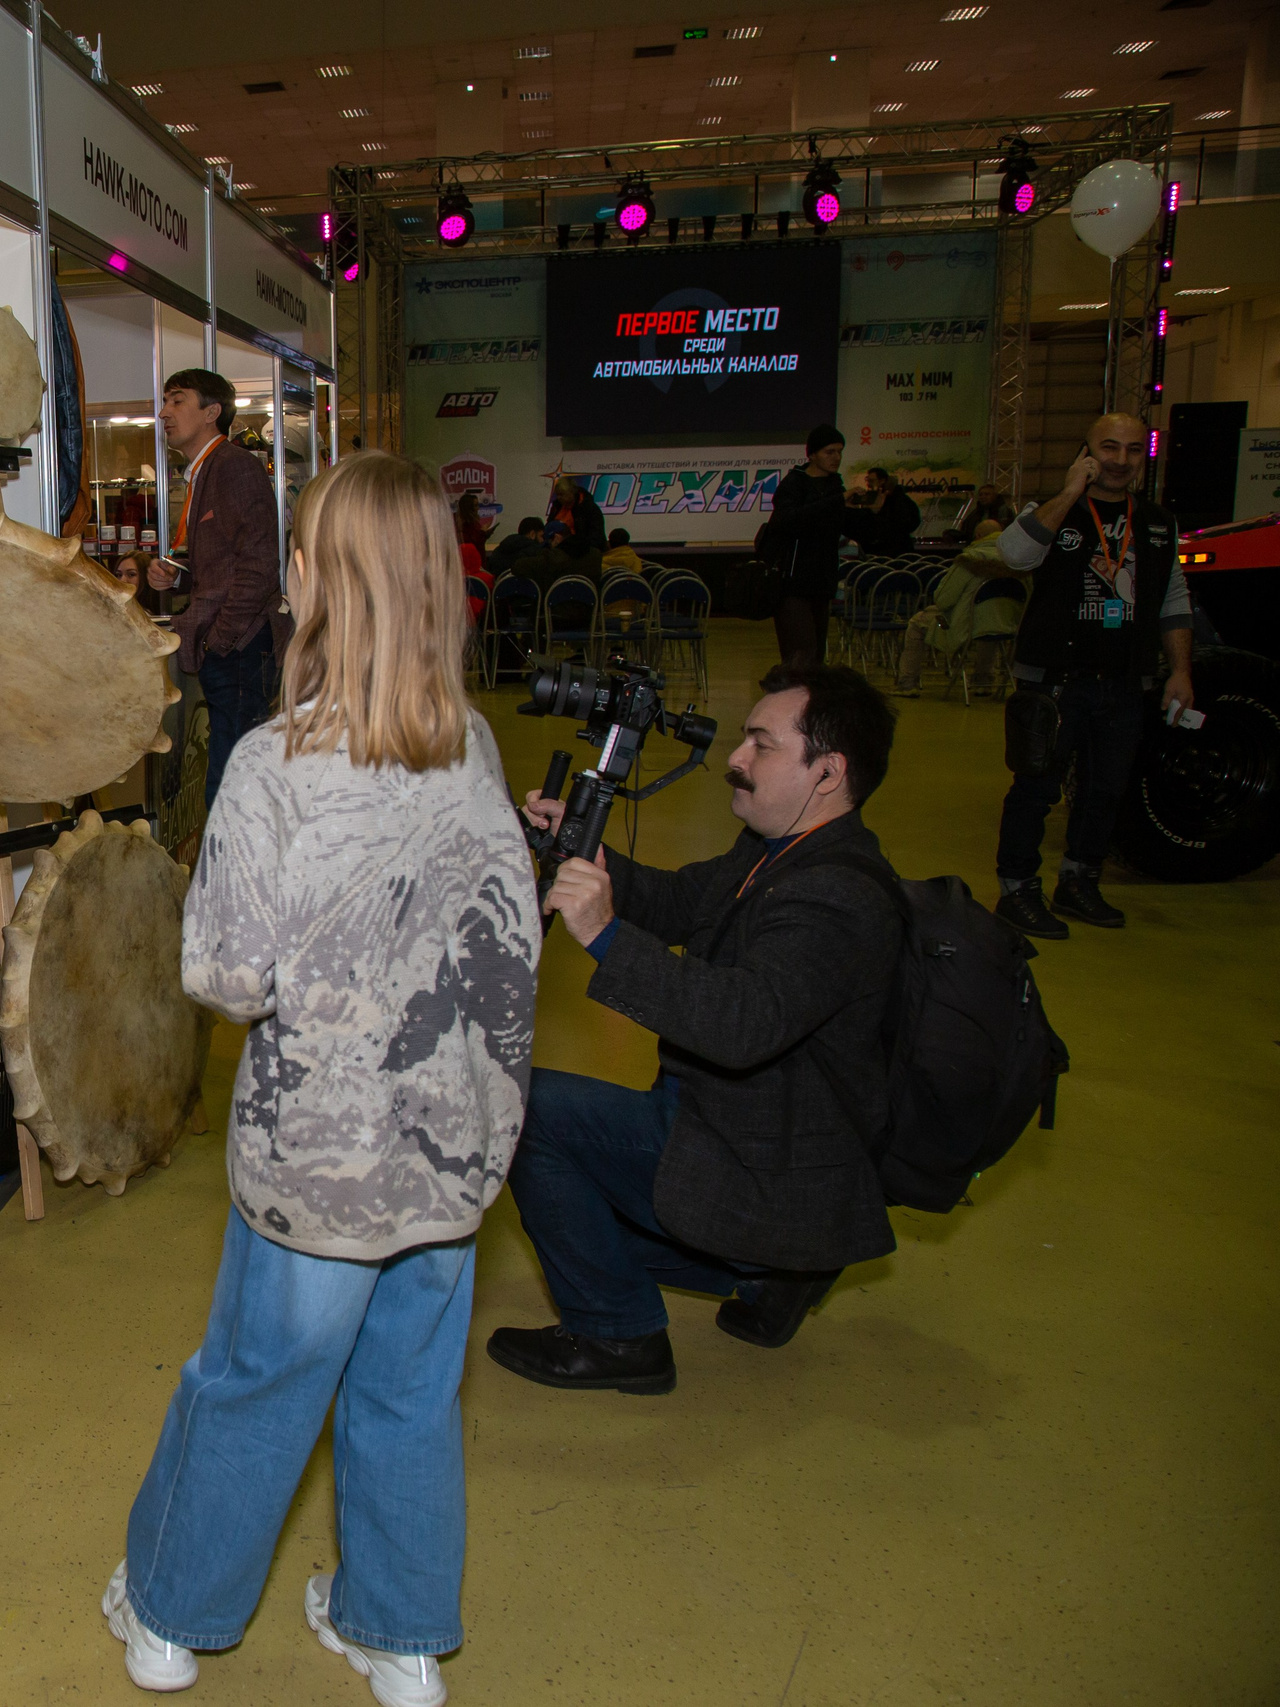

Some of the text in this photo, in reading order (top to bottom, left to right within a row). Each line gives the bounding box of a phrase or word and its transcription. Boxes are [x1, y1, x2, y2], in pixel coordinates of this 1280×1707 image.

[83, 136, 188, 252] HAWK-MOTO.COM
[434, 276, 521, 290] ЭКСПОЦЕНТР
[255, 268, 307, 327] HAWK-MOTO.COM
[615, 306, 780, 338] ПЕРВОЕ МЕСТО
[406, 339, 542, 366] ПОЕХАЛИ
[683, 337, 726, 354] СРЕДИ
[592, 354, 799, 378] АВТОМОБИЛЬНЫХ КАНАЛОВ
[442, 393, 494, 408] АВТО
[878, 429, 971, 440] одноклассники
[596, 462, 635, 470] ВЫСТАВКА
[636, 460, 691, 469] ПУТЕШЕСТВИЙ
[699, 459, 733, 468] ТЕХНИКИ
[734, 459, 751, 467] ДЛЯ
[751, 458, 796, 466] АКТИВНОГО
[446, 467, 490, 485] САЛОН
